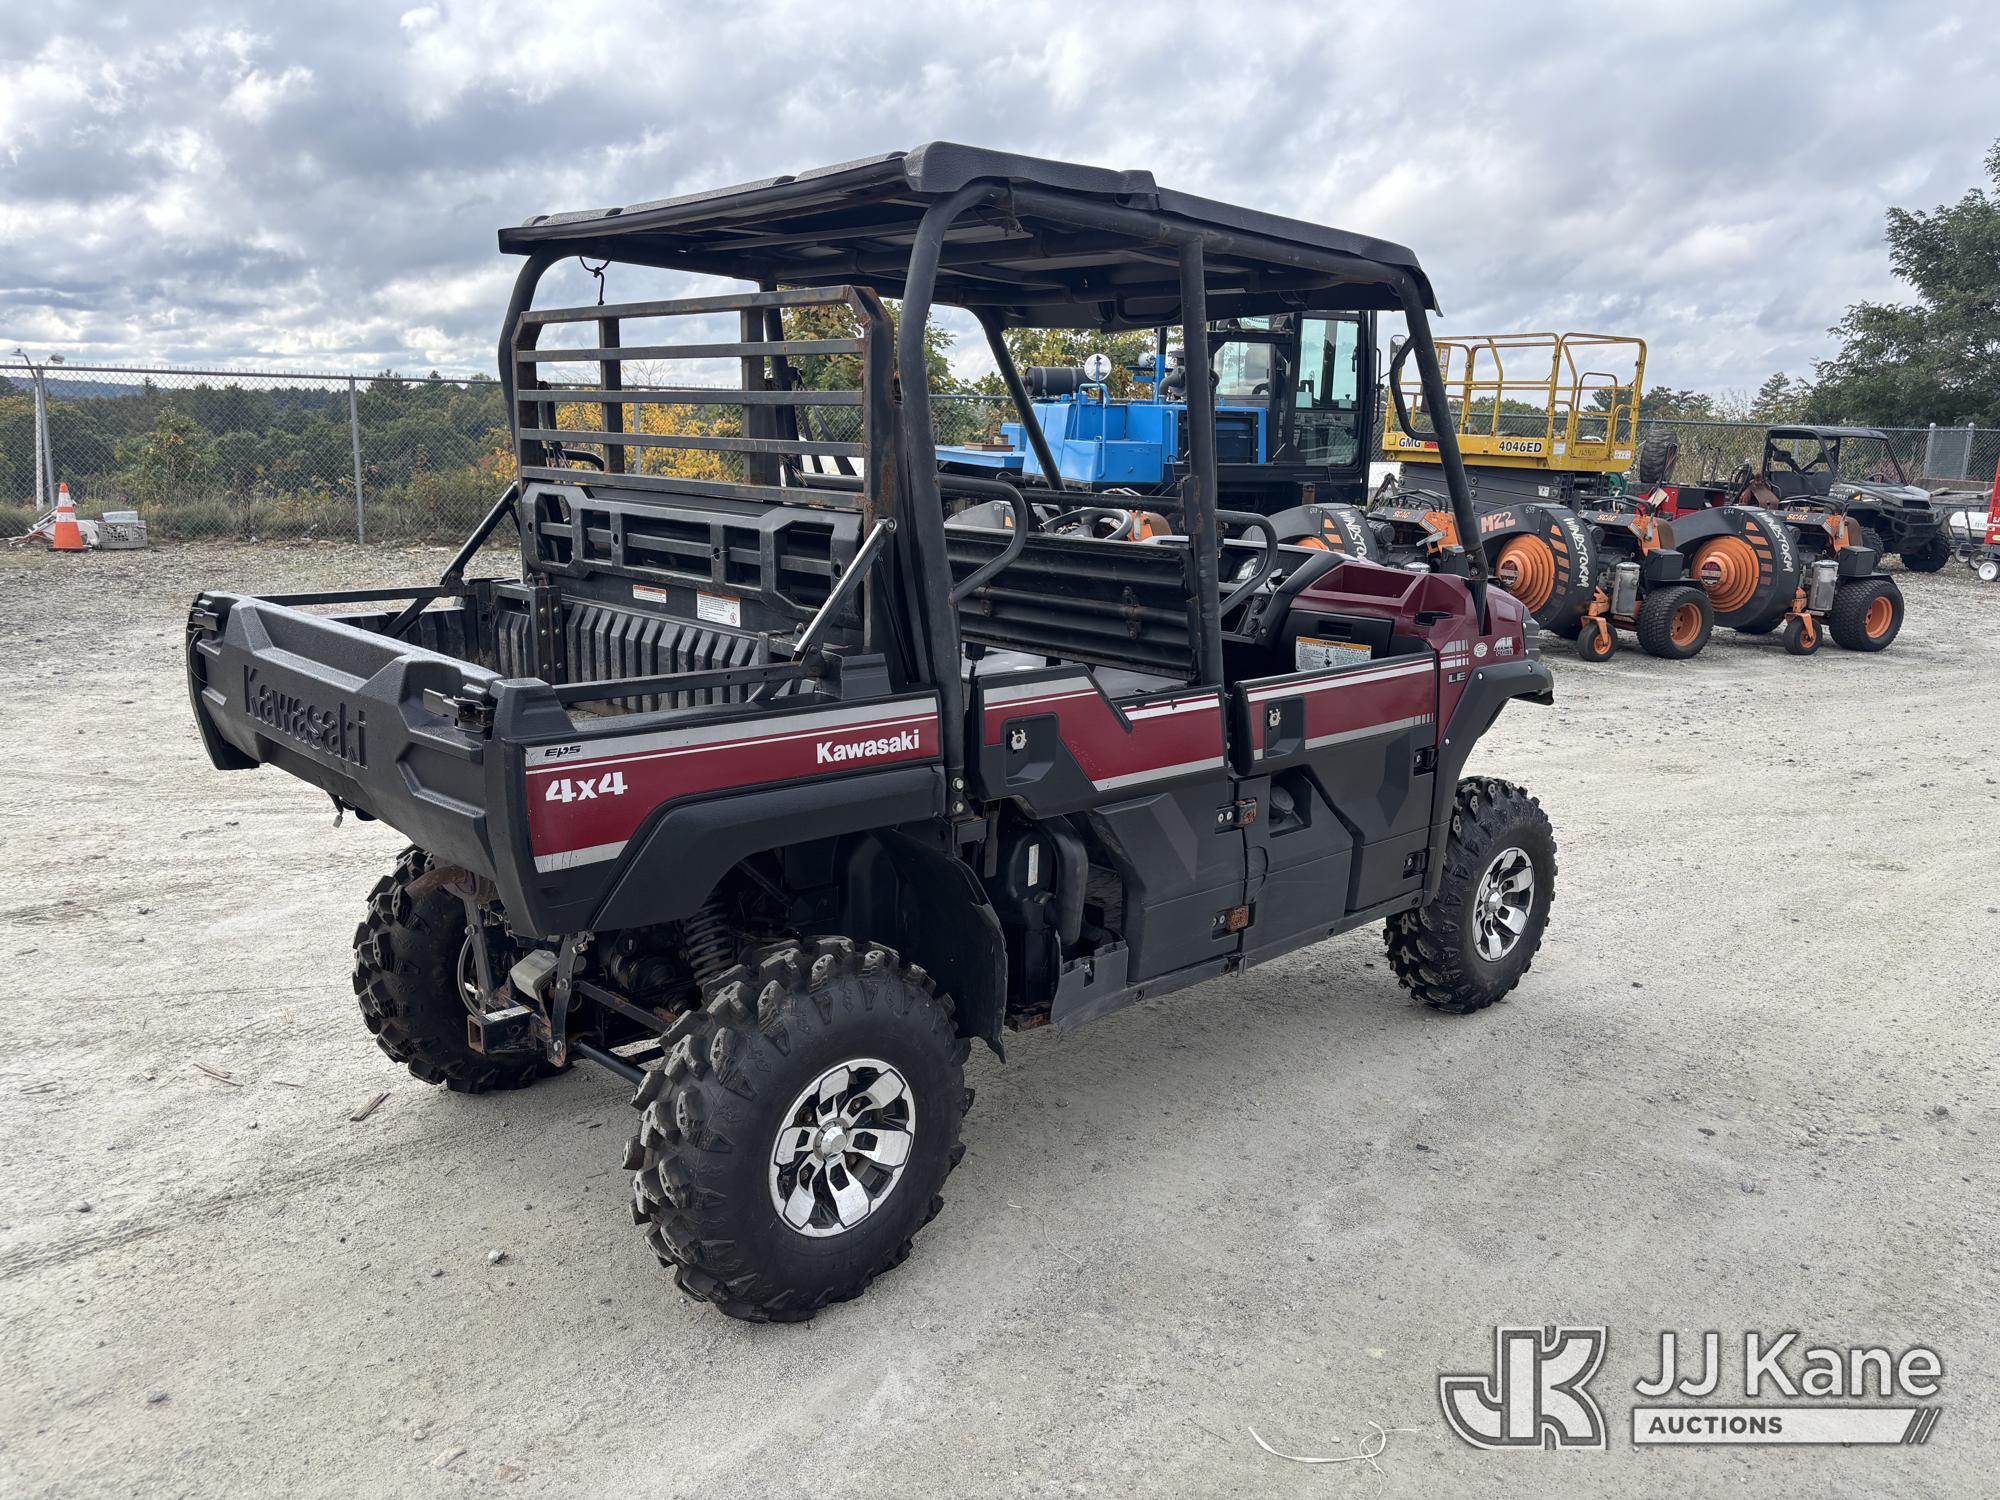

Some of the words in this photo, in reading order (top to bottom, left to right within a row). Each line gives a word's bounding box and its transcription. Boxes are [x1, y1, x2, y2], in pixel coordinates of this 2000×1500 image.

[1399, 438, 1421, 448] GMG
[1498, 441, 1542, 453] 4046ED
[1480, 511, 1516, 533] M22
[1786, 513, 1809, 521] SCAG
[1337, 511, 1367, 560] WINDSTO
[1757, 512, 1793, 573] WINDSTORM
[1563, 517, 1590, 588] WINDSTORM
[1448, 672, 1466, 684] LE
[243, 664, 369, 769] Kawasaki
[544, 745, 582, 758] EPS
[816, 729, 920, 764] Kawasaki
[545, 771, 628, 803] 4x4
